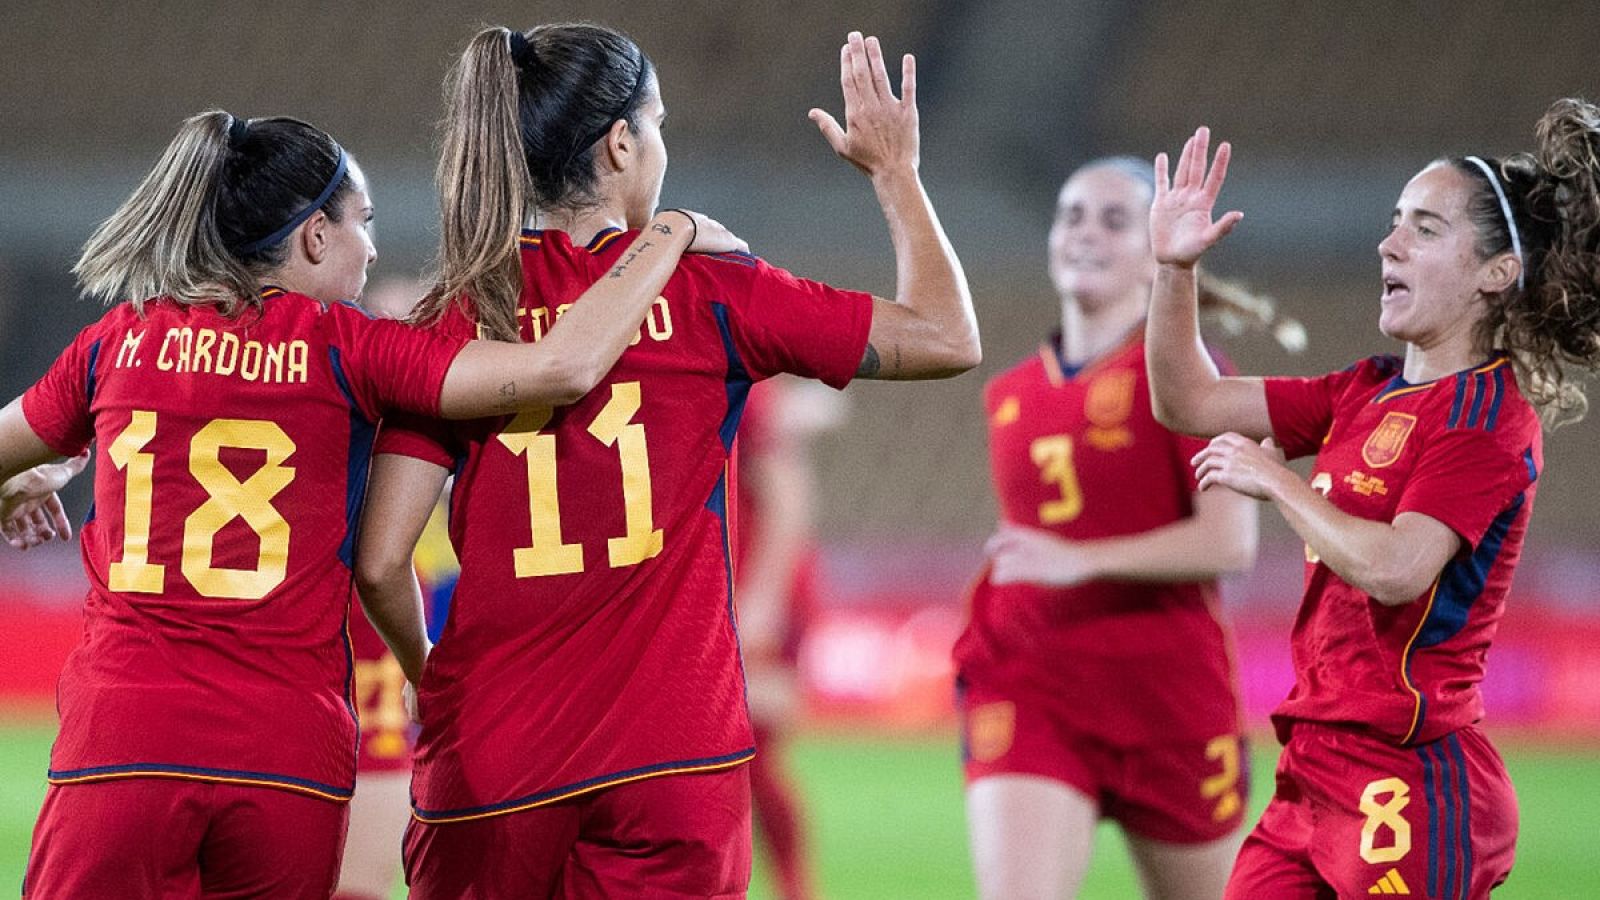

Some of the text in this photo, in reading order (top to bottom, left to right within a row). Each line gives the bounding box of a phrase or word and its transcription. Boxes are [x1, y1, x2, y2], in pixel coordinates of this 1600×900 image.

[115, 327, 309, 383] M. CARDONA
[107, 410, 297, 600] 18
[496, 381, 664, 578] 11
[1029, 434, 1083, 524] 3
[1202, 736, 1239, 797] 3
[1359, 777, 1411, 864] 8
